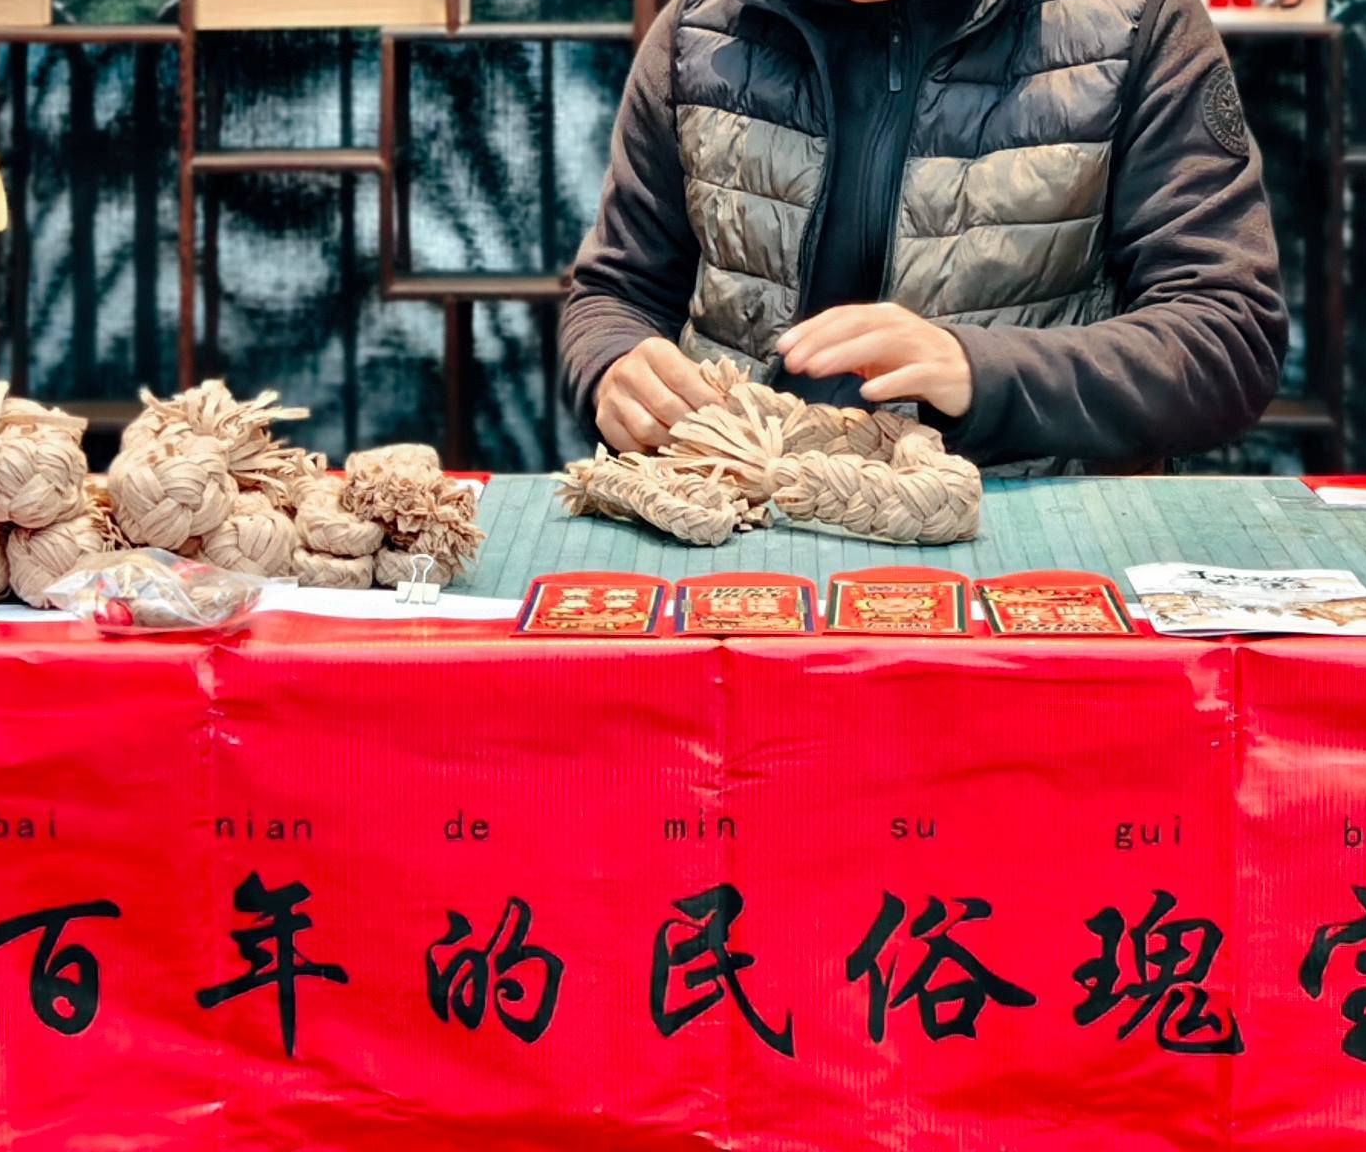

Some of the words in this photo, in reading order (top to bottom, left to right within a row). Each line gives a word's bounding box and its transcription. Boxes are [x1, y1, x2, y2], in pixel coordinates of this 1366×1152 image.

[216, 814, 315, 841] nian
[443, 812, 490, 841] de
[663, 812, 738, 841] min
[890, 818, 938, 841] su
[1115, 814, 1182, 849] gui
